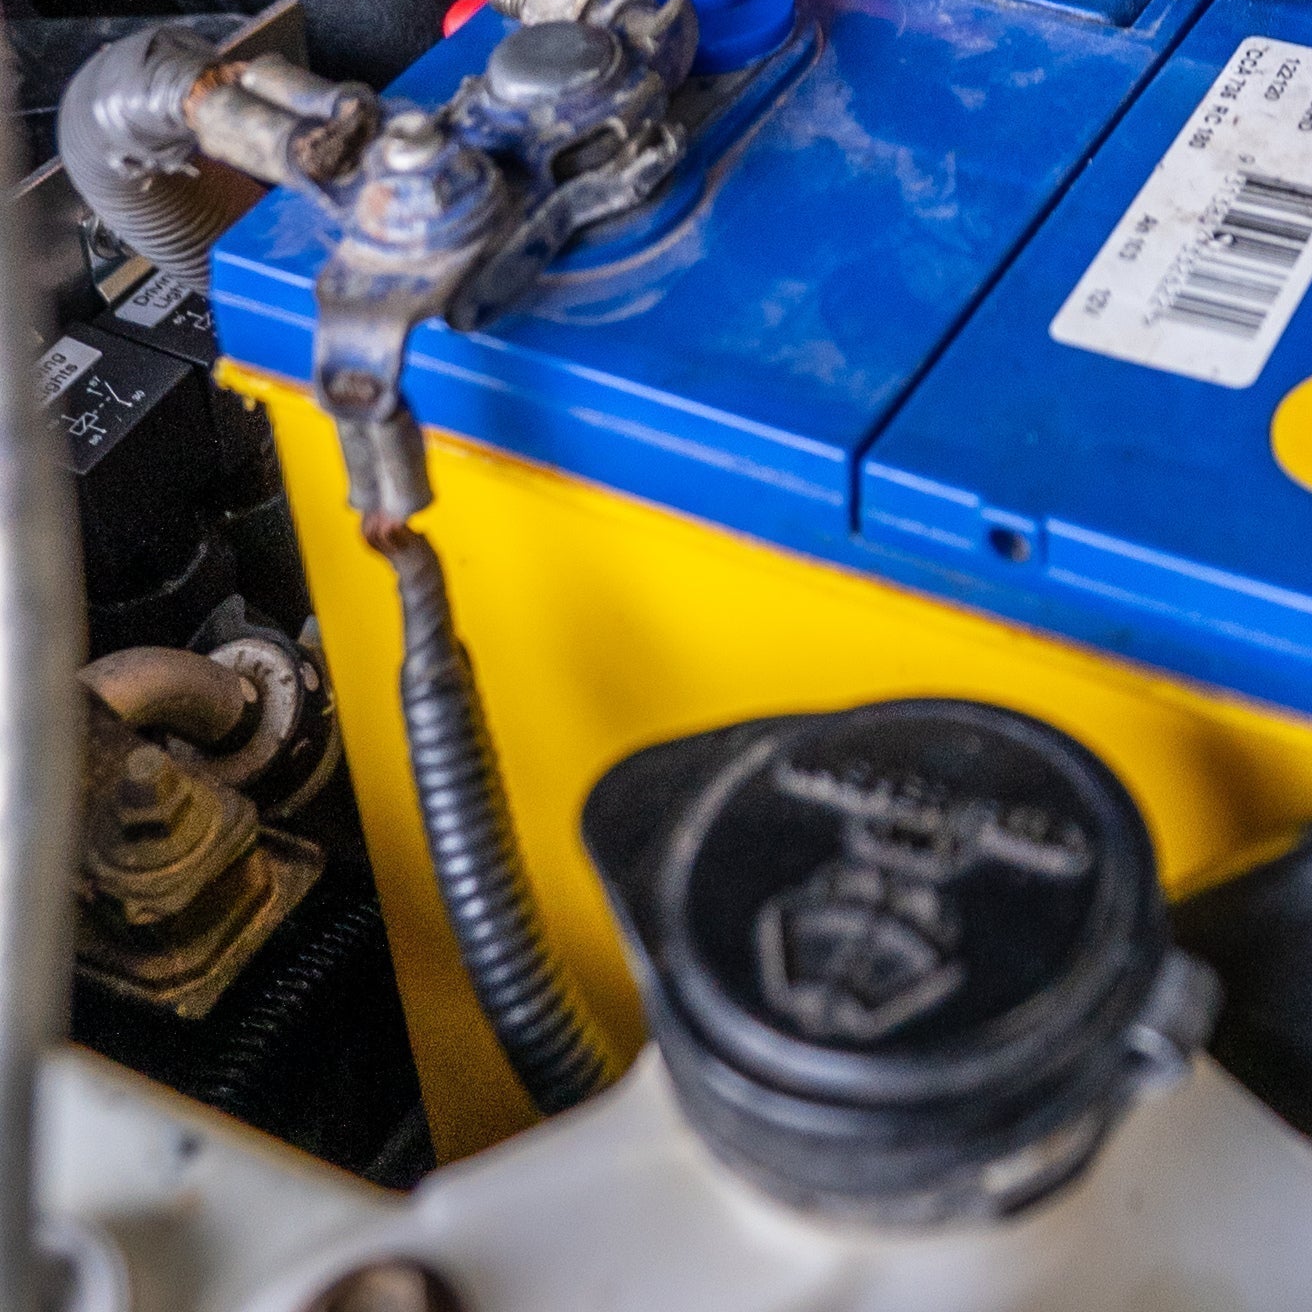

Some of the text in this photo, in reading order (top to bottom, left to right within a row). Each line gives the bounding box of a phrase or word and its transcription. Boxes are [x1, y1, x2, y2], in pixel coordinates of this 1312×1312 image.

[1236, 49, 1264, 75] CCA
[1263, 57, 1301, 102] 122120
[1204, 104, 1229, 125] RC
[132, 271, 172, 307] Drivin
